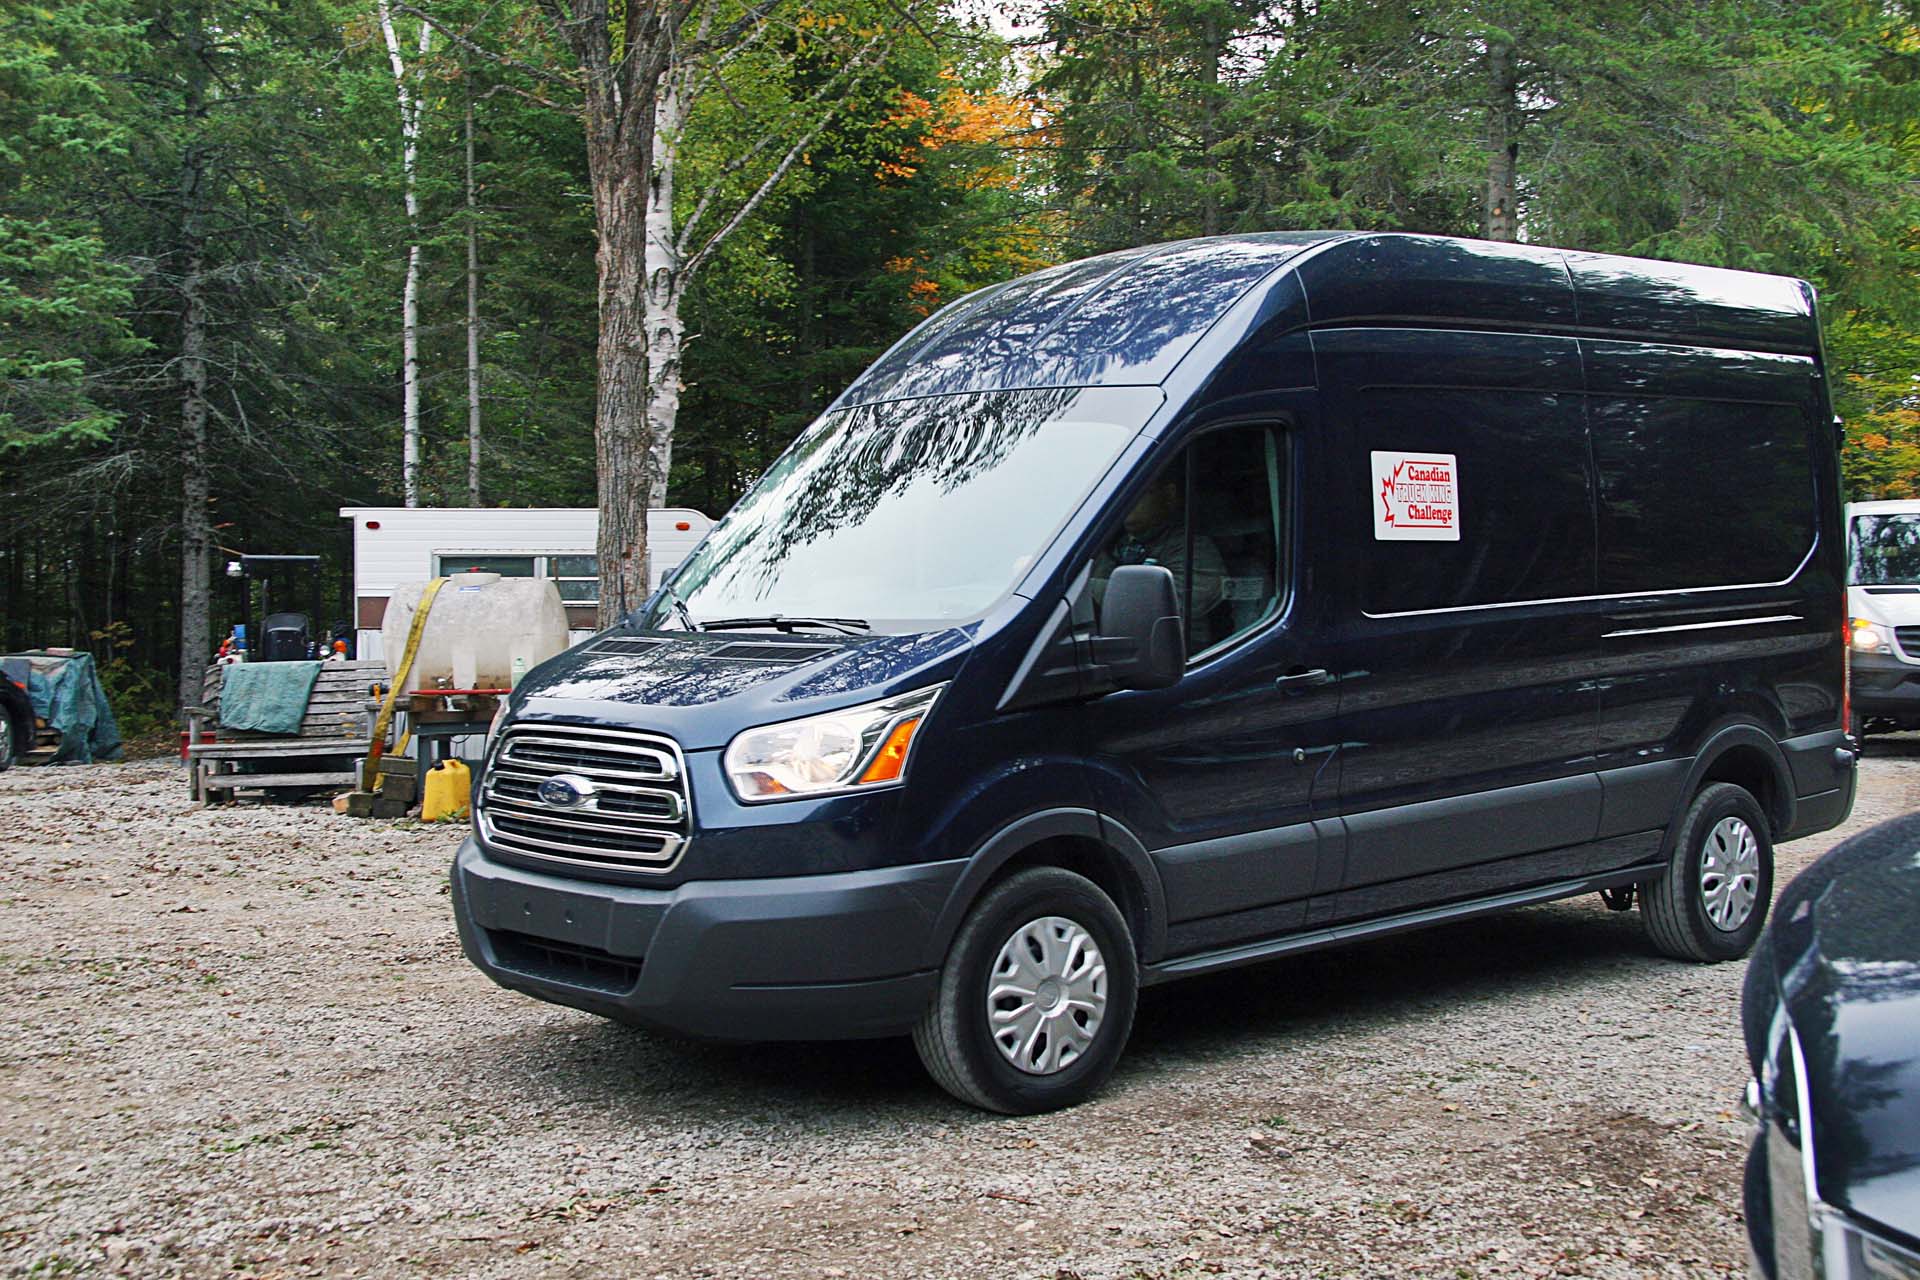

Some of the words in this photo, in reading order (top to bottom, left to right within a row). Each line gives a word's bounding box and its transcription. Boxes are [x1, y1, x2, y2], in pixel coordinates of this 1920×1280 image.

[1408, 466, 1450, 481] Canadian
[1396, 483, 1427, 503] TRUCK
[1429, 484, 1451, 504] KING
[1408, 504, 1452, 523] Challenge
